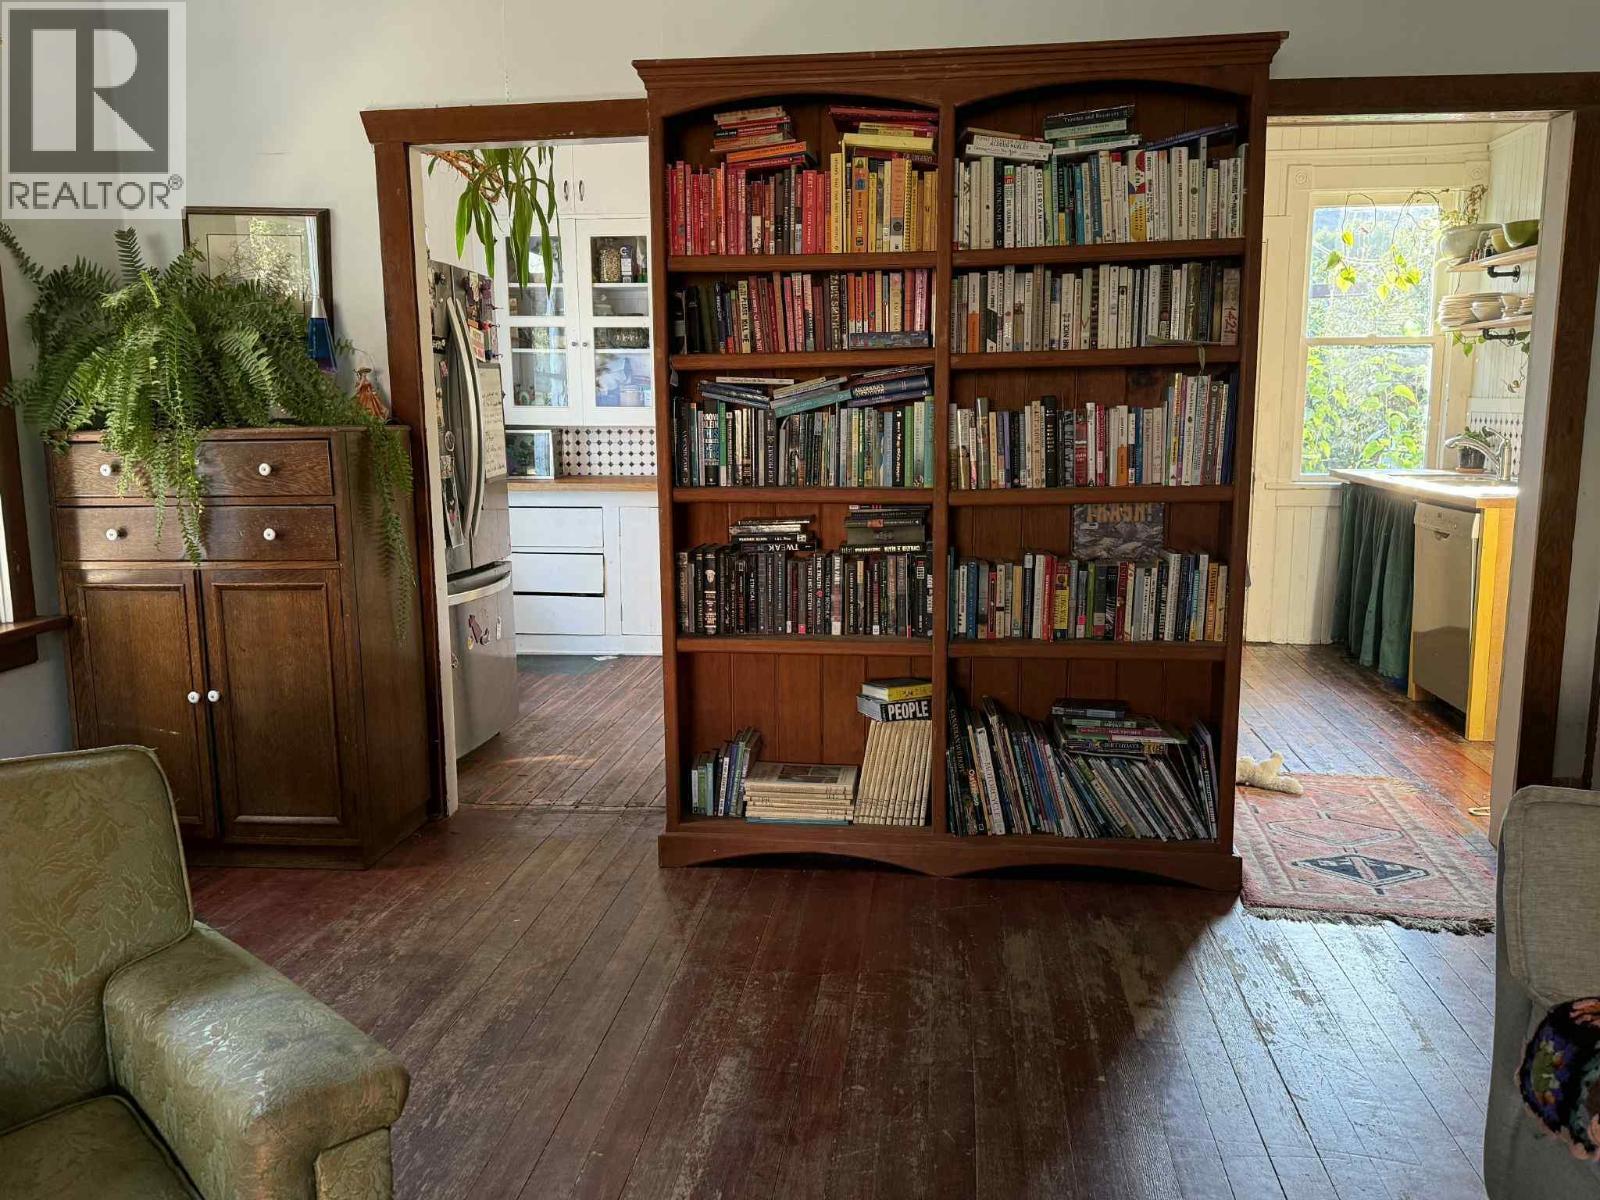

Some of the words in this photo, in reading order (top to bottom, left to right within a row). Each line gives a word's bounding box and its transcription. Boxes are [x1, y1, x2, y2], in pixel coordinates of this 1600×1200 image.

[830, 301, 839, 328] SMITH
[1224, 306, 1237, 334] 1421
[742, 335, 749, 343] ME
[767, 544, 798, 552] TWEAK
[887, 701, 929, 721] PEOPLE
